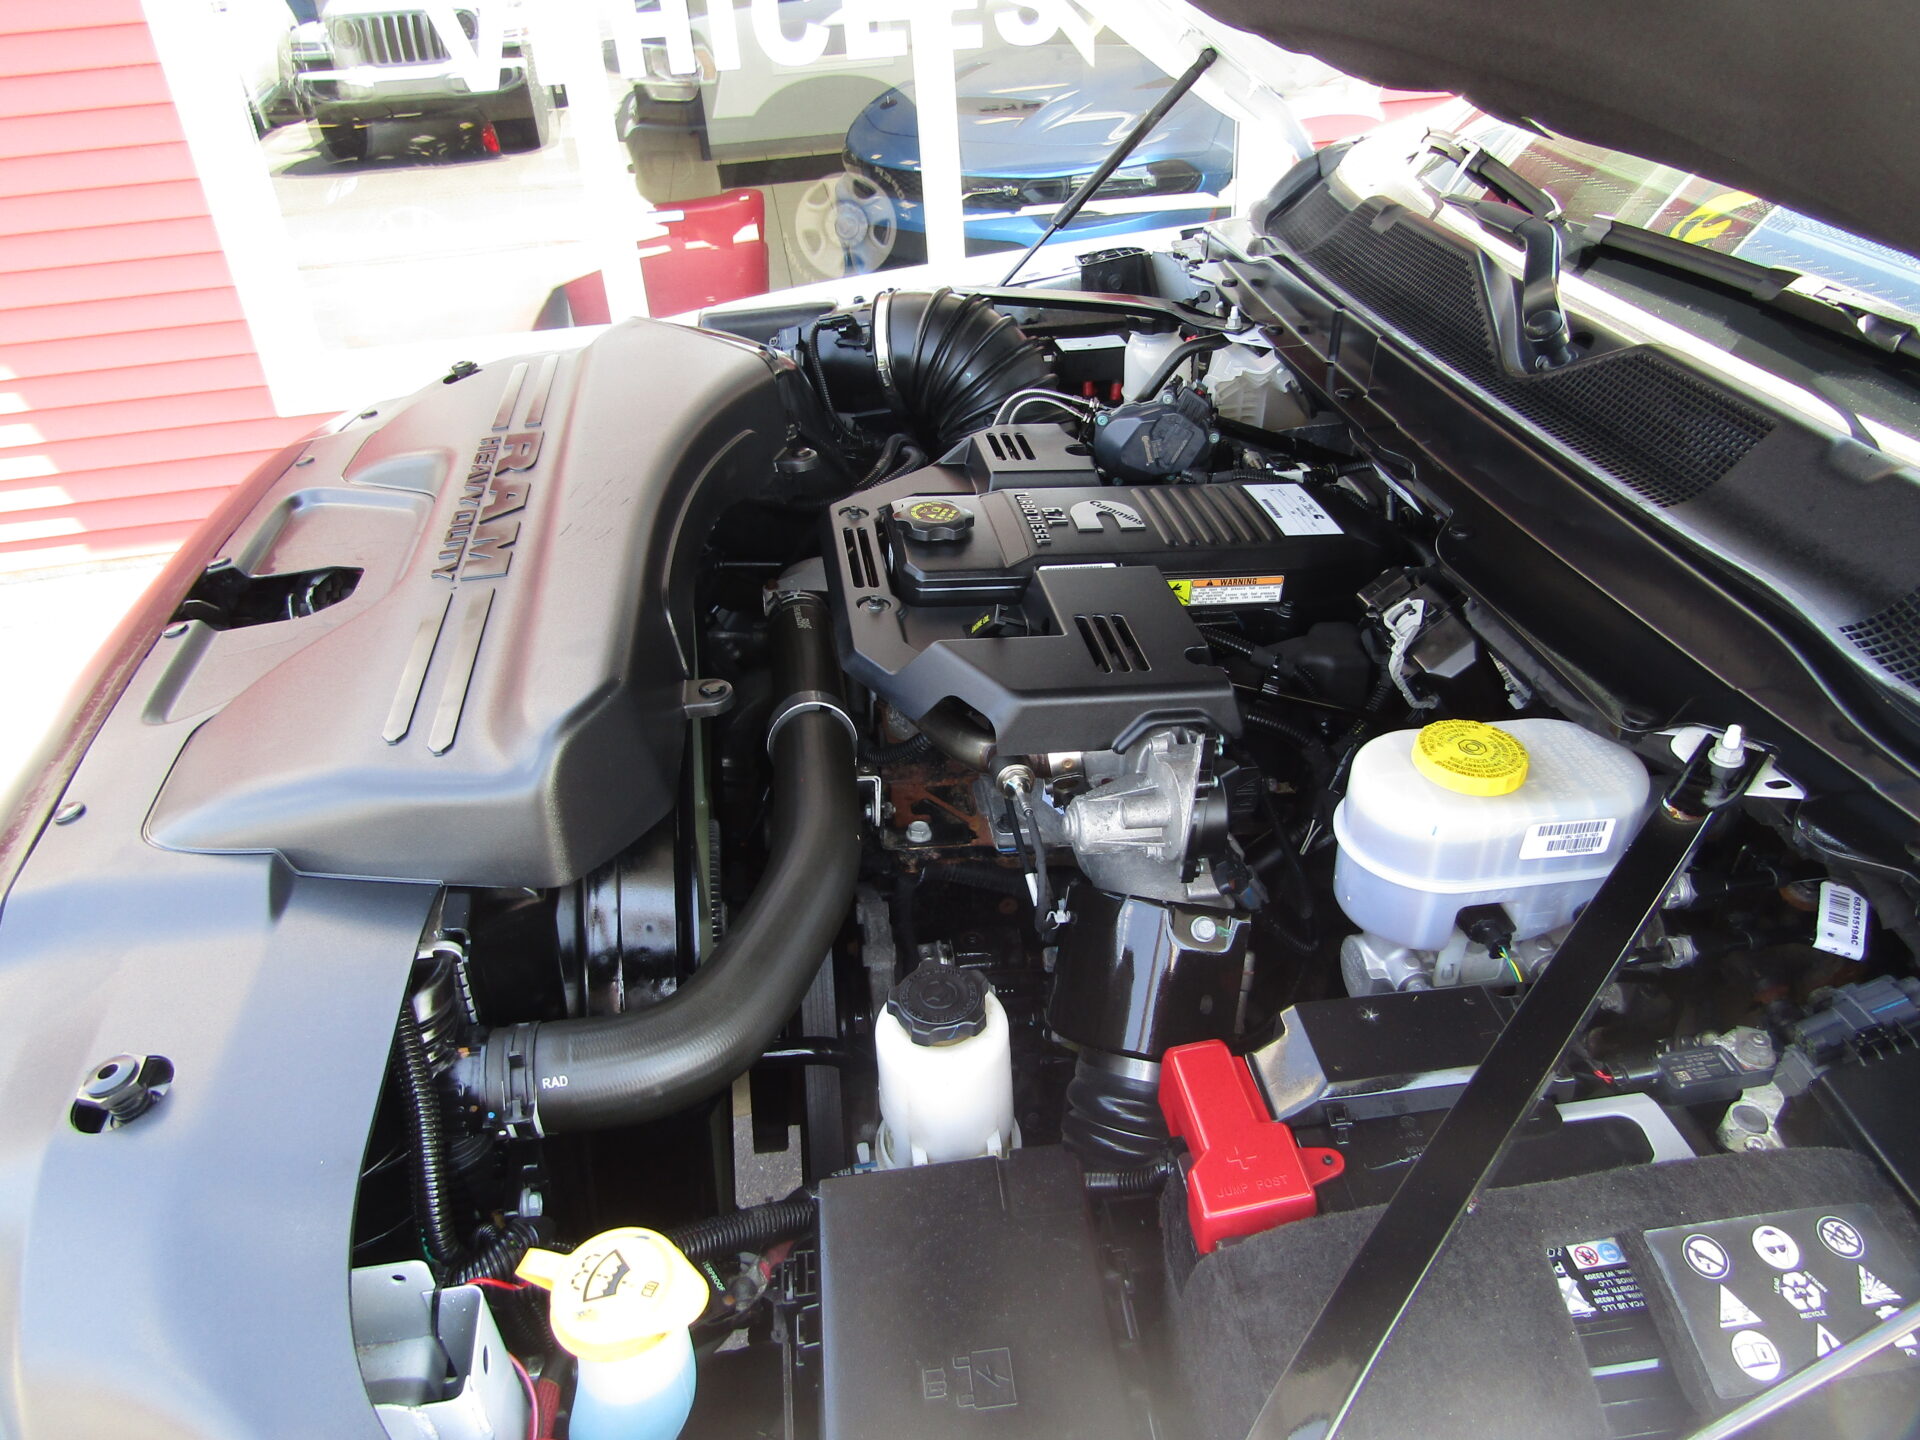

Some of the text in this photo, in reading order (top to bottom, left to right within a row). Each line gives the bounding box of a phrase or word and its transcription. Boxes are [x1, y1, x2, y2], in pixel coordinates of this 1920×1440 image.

[431, 436, 502, 581] HEAVY DUTY
[460, 431, 545, 581] RAM
[1041, 506, 1069, 526] 6.7L
[1089, 500, 1143, 526] Cummins
[1026, 514, 1052, 545] DIESEL
[1220, 577, 1258, 586] WARNING
[1850, 896, 1862, 946] 68351519AC
[542, 1075, 569, 1089] RAD
[1217, 1174, 1288, 1199] JUMP POST
[1598, 1279, 1614, 1287] LLC
[1601, 1303, 1617, 1312] LLC
[1626, 1300, 1646, 1309] FCA
[1799, 1309, 1828, 1319] RECYCLE
